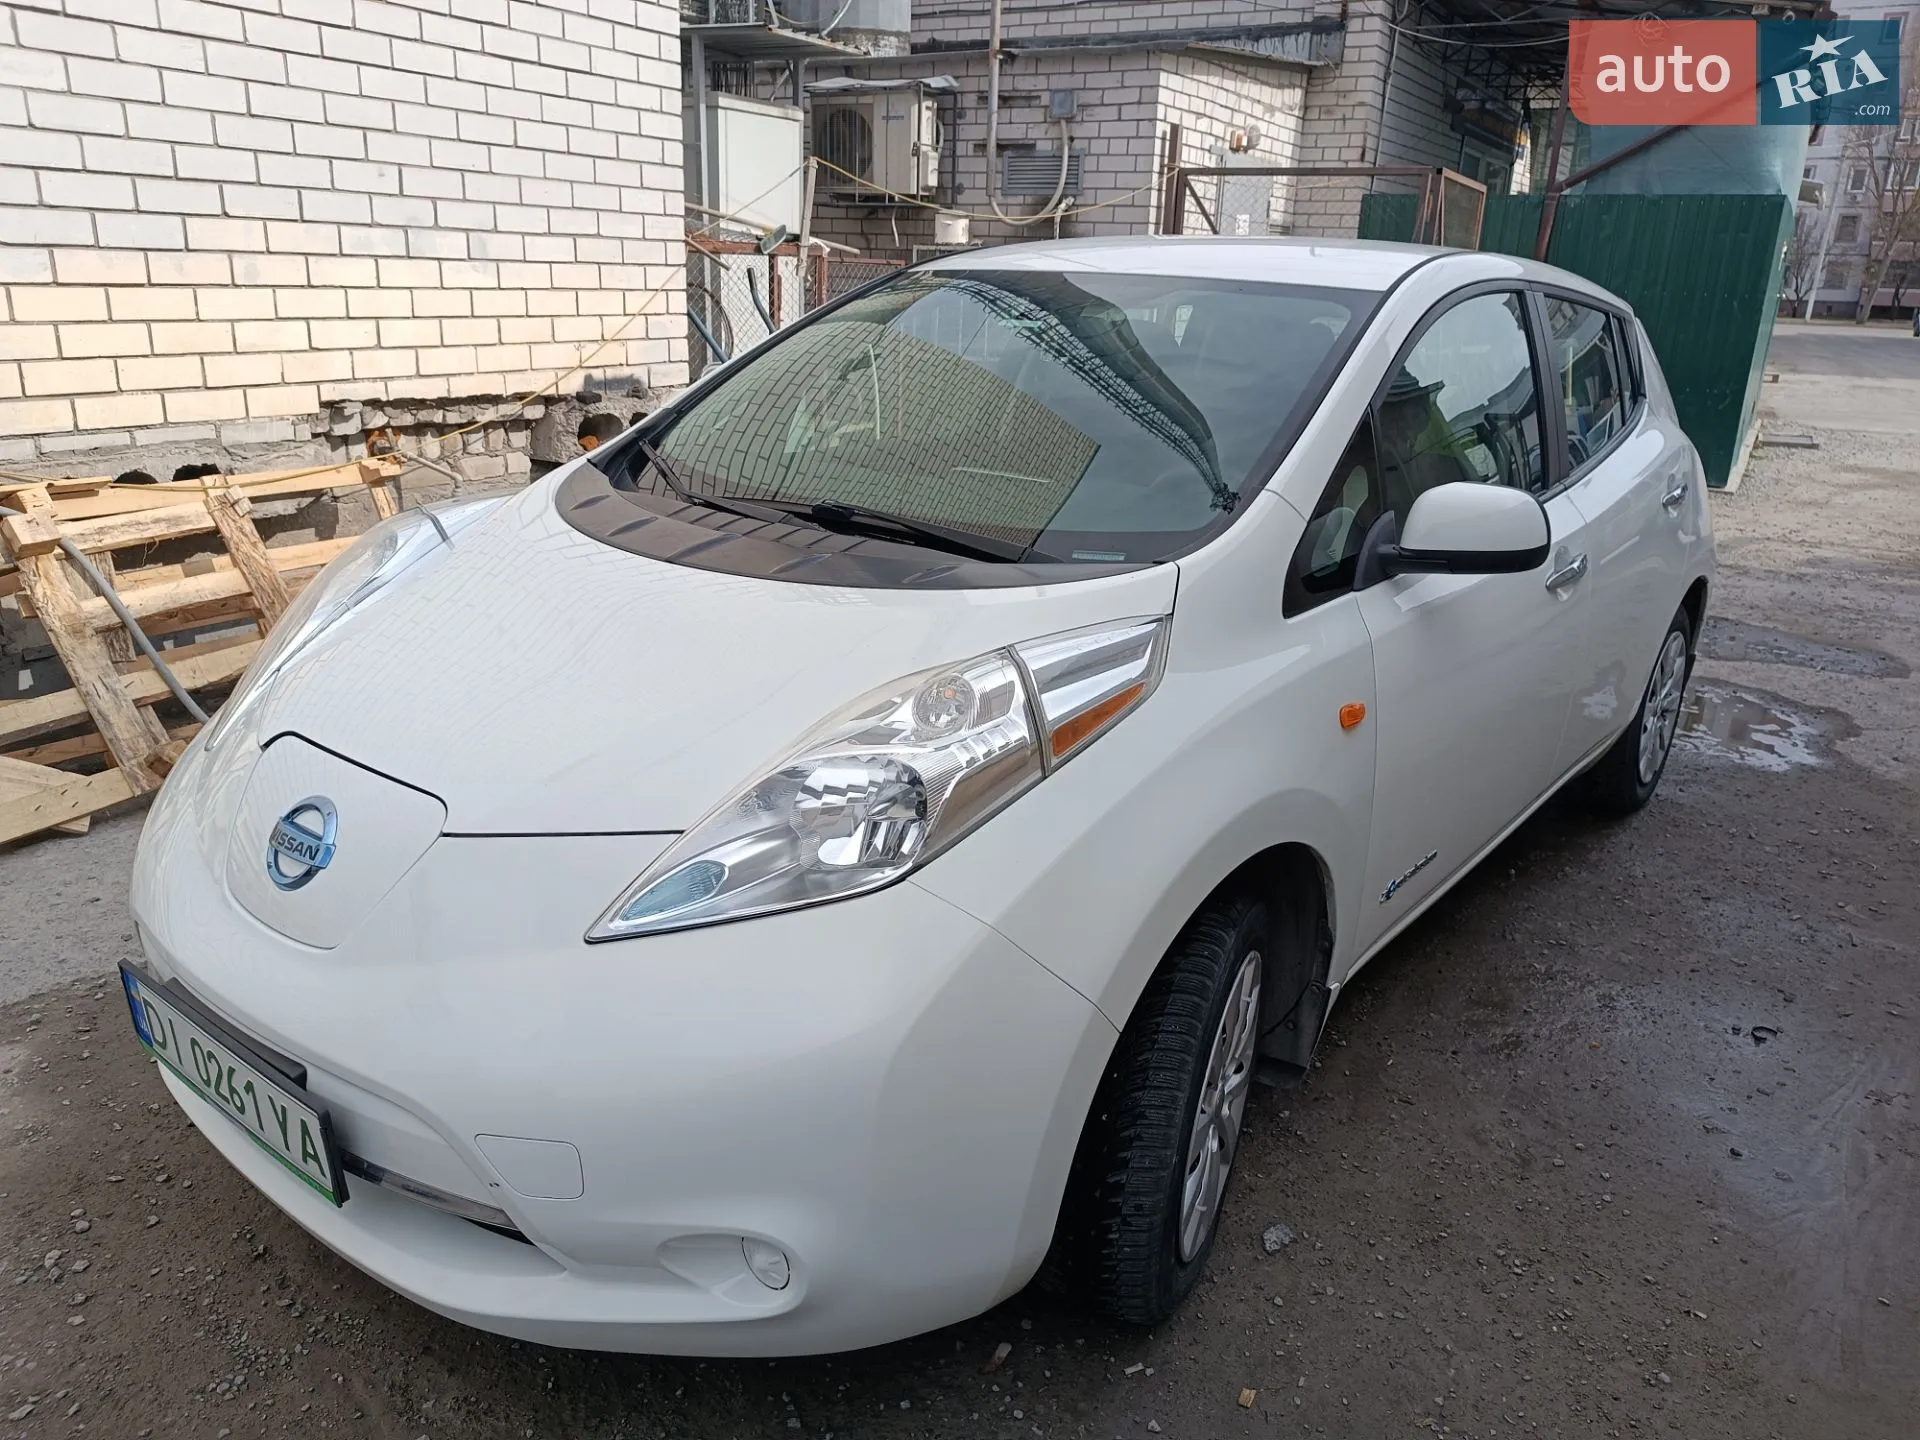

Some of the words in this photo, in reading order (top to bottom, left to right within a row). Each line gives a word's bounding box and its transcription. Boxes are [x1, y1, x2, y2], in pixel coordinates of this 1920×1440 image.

[269, 828, 320, 861] NISSAN
[142, 996, 184, 1067] DI
[190, 1036, 265, 1133] 0261
[268, 1094, 327, 1178] YA
